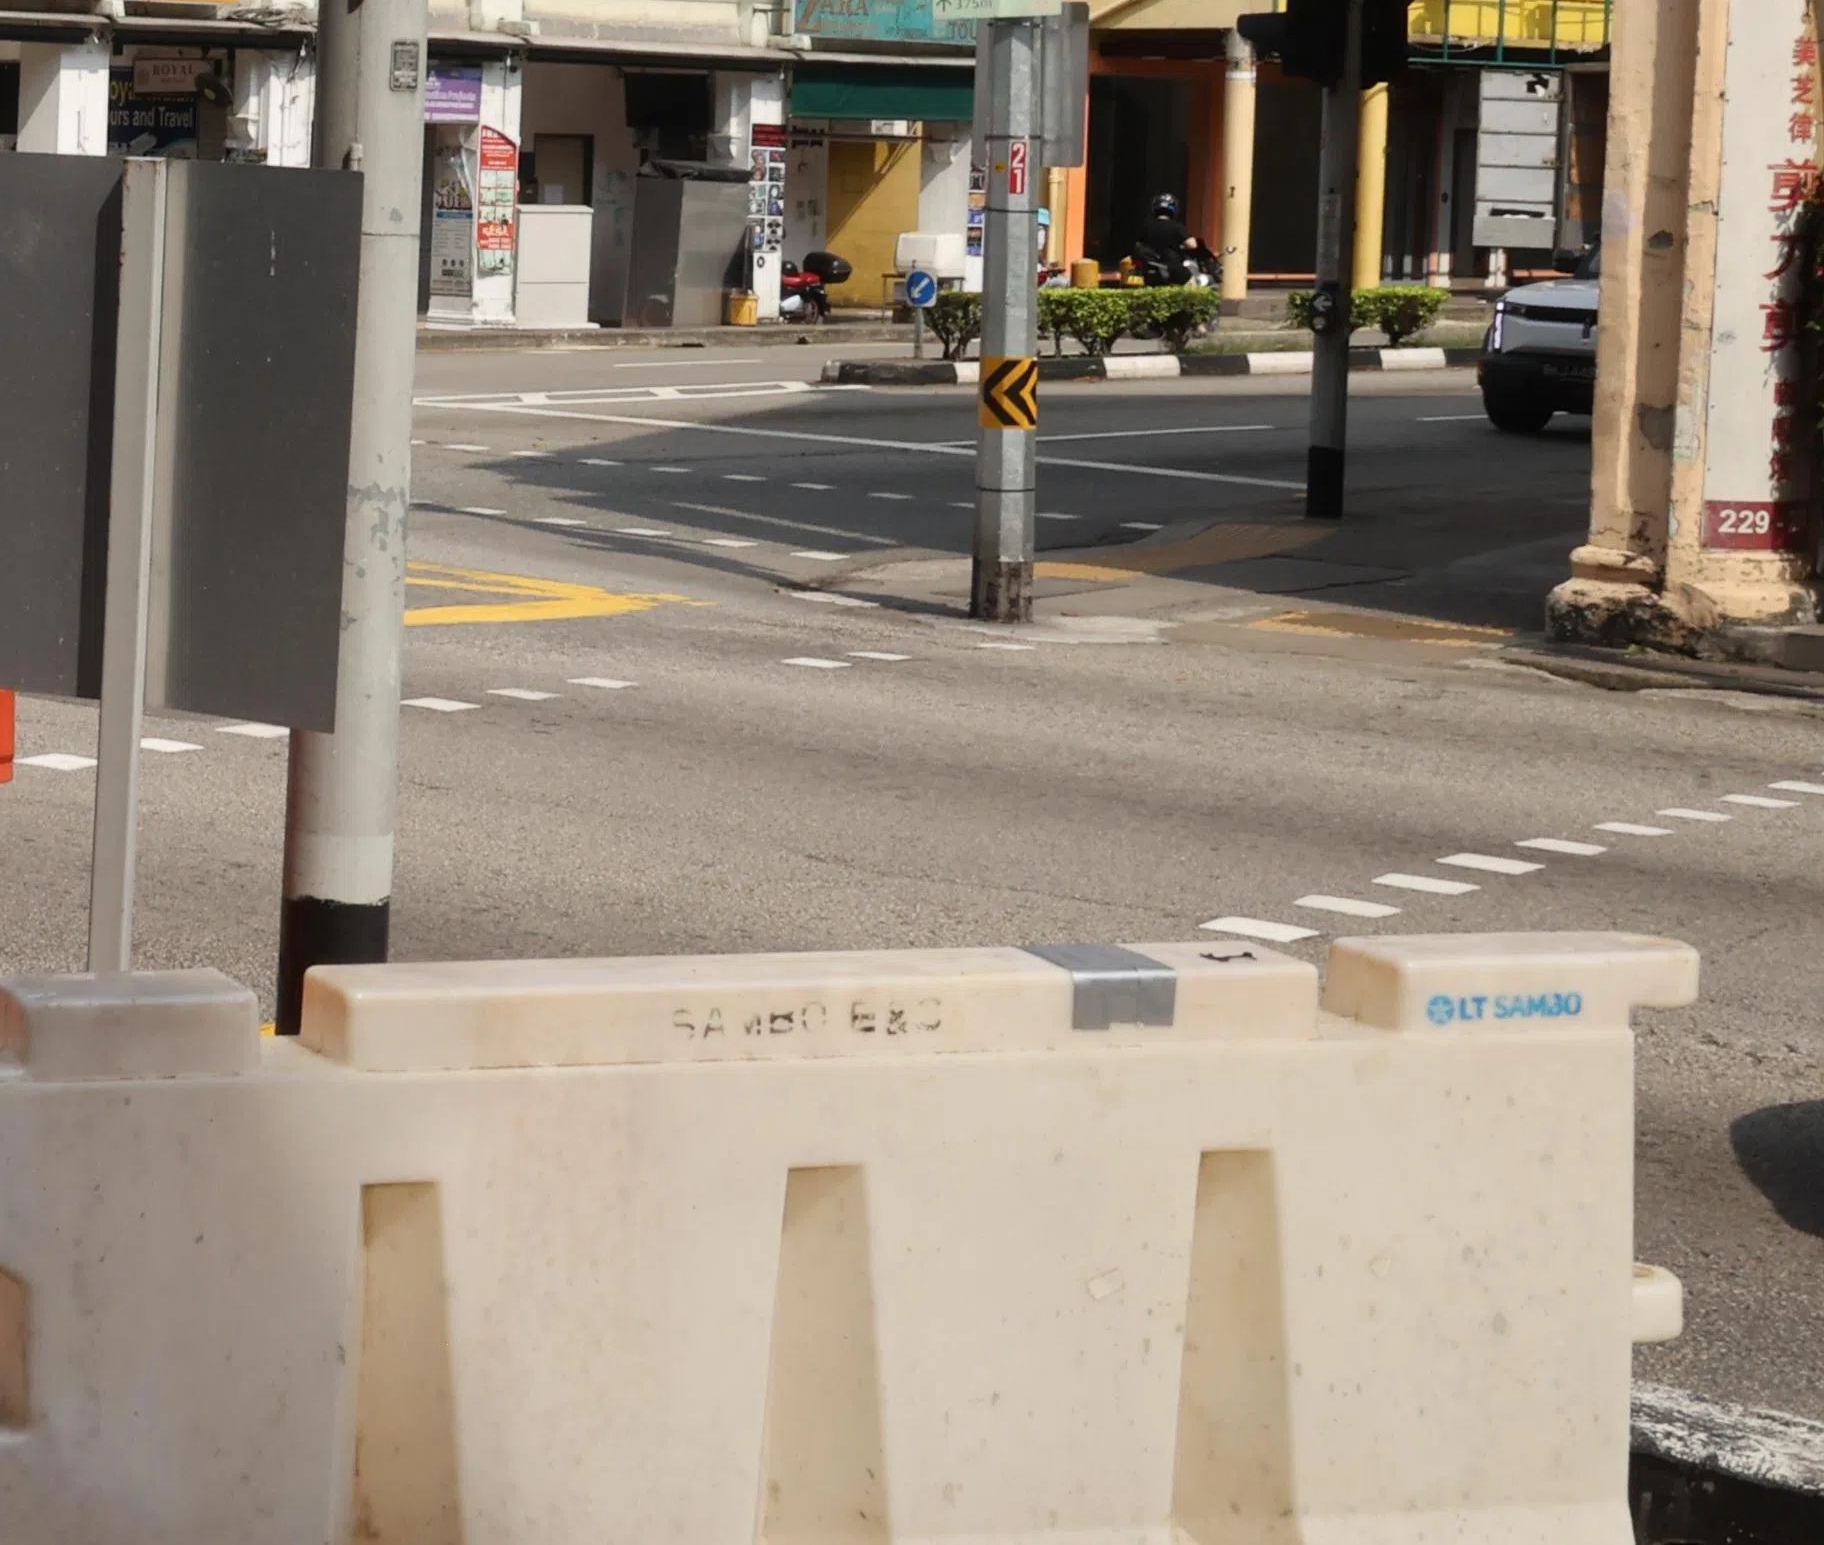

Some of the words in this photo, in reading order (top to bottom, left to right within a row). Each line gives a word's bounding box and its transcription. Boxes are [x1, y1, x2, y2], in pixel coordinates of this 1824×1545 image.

[948, 21, 977, 40] TOU
[132, 106, 155, 127] and
[1012, 142, 1027, 193] 21
[1459, 994, 1488, 1021] LT
[1493, 991, 1583, 1019] SAMBO
